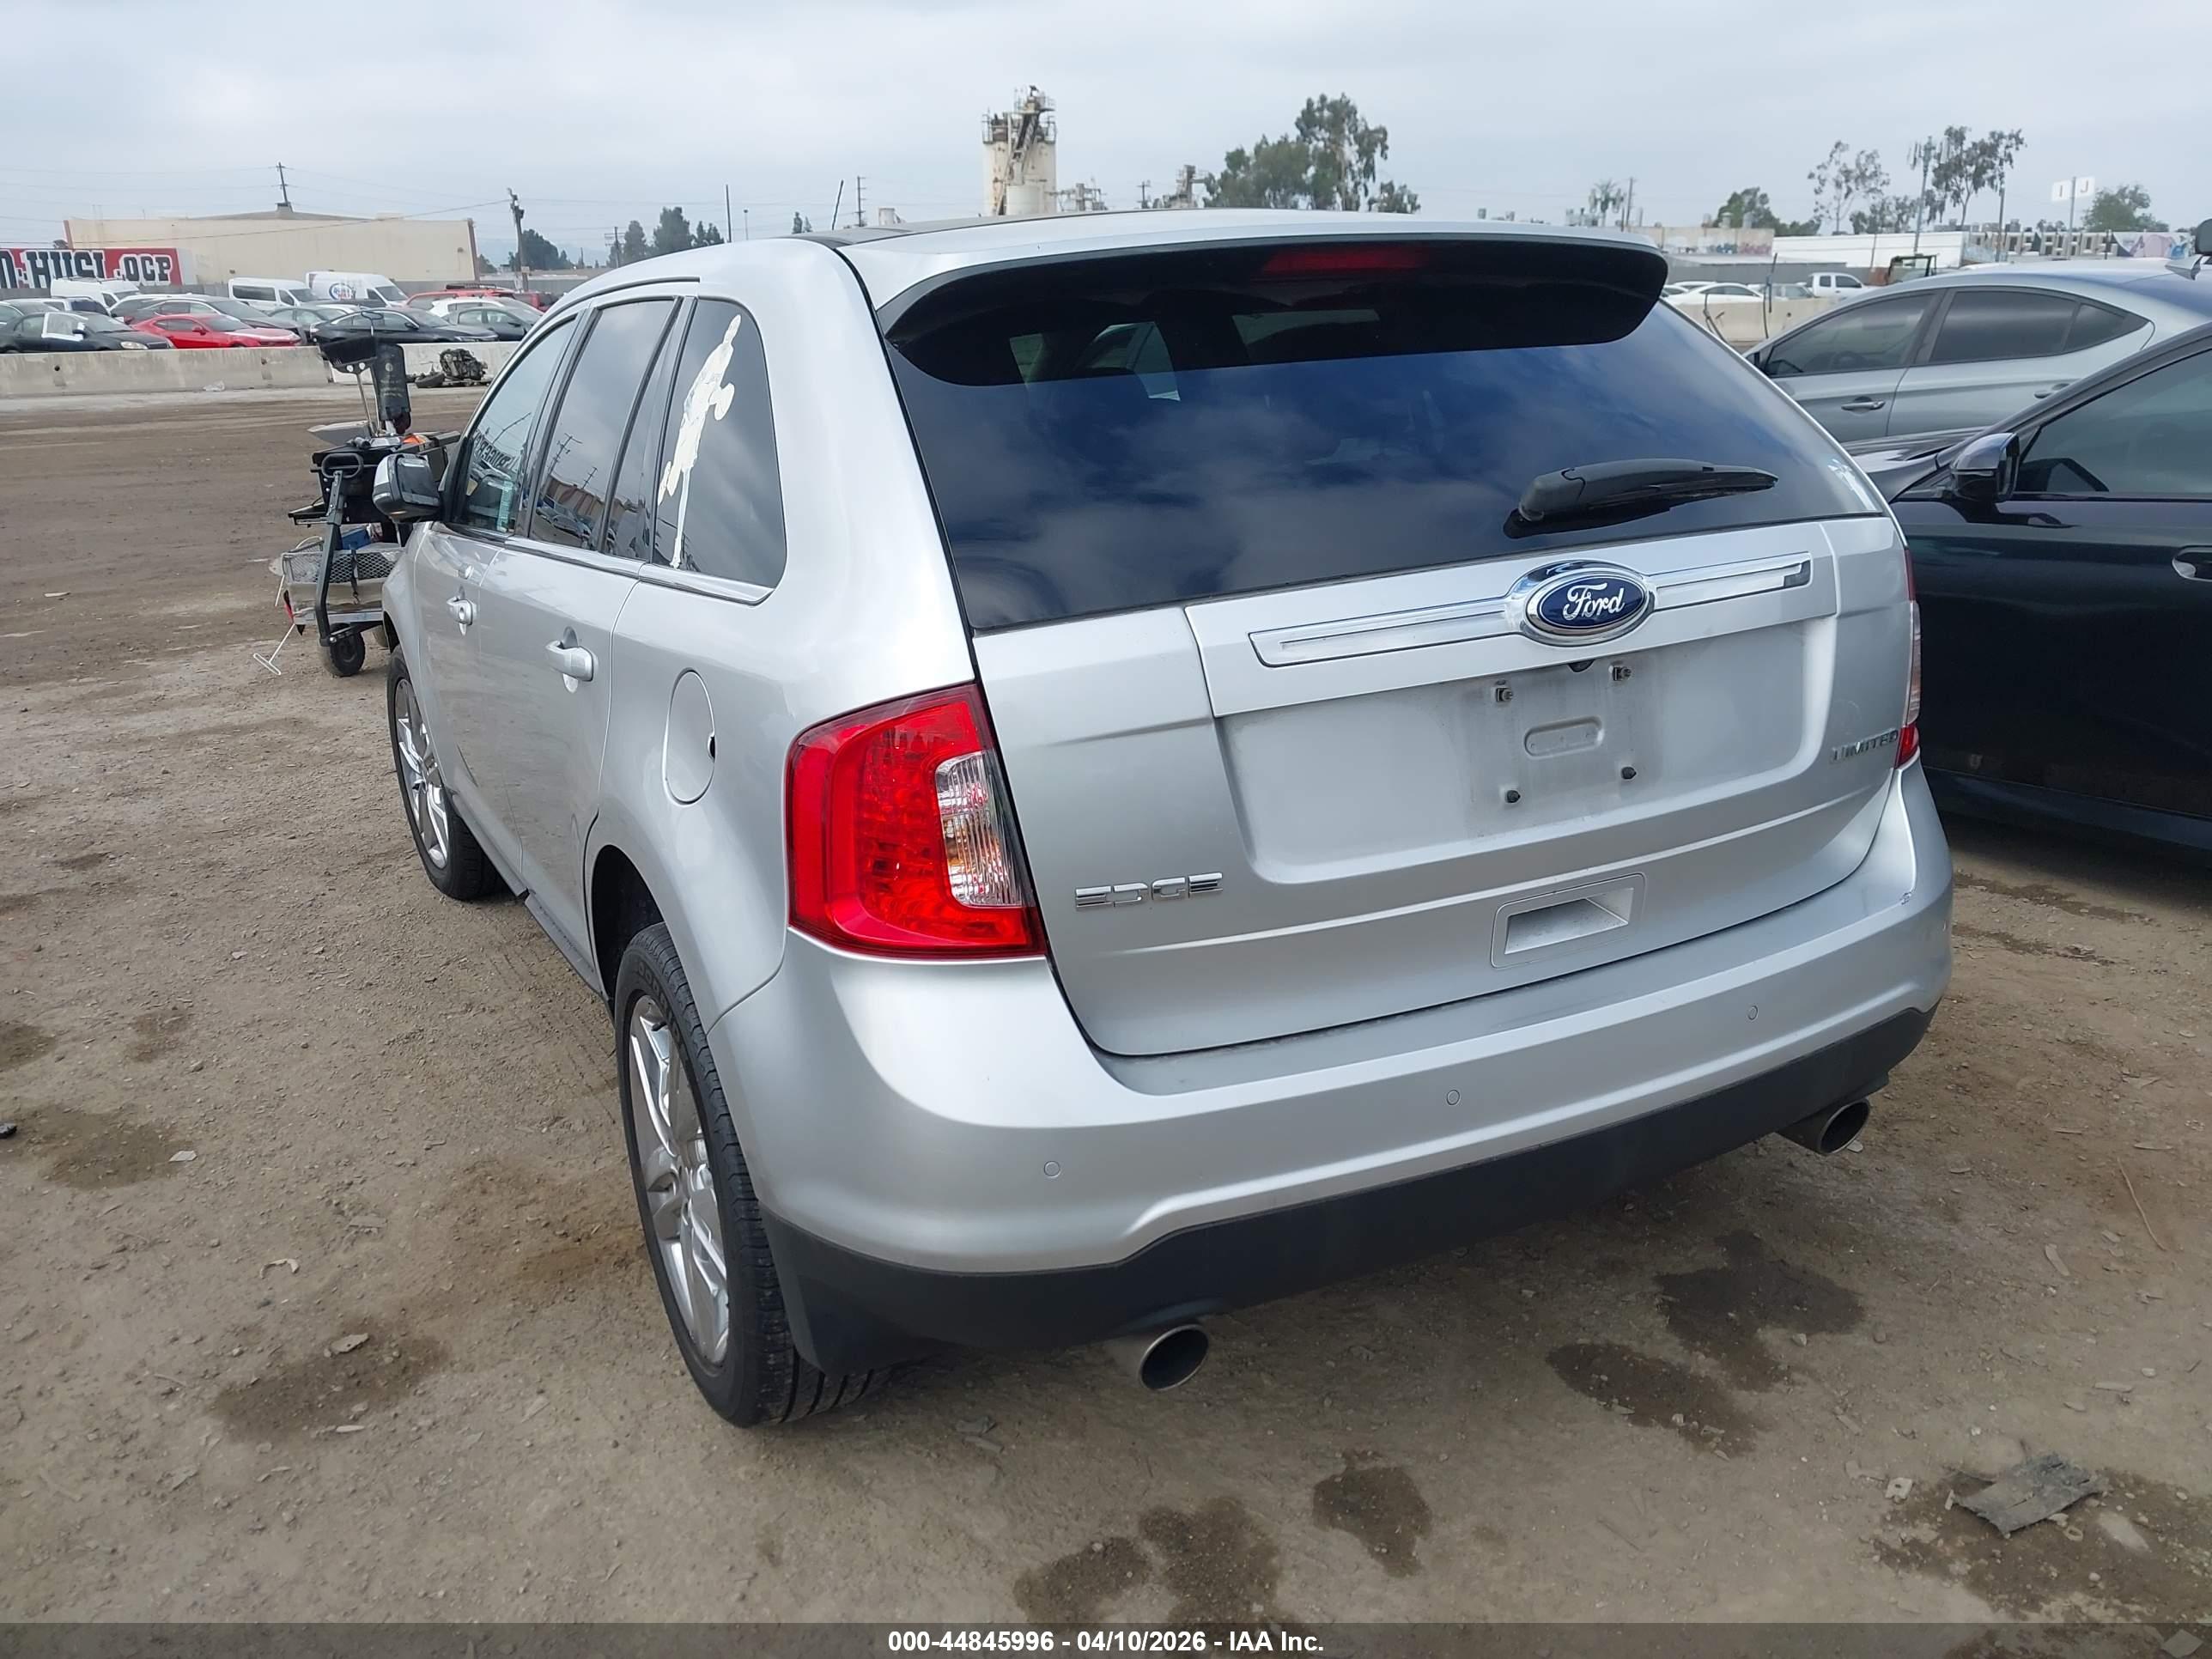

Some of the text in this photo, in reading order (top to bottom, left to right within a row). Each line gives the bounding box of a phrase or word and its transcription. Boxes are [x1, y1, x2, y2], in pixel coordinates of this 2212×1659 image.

[1563, 583, 1625, 620] Ford
[1831, 728, 1899, 762] LIMITED
[1075, 872, 1224, 908] EDGE
